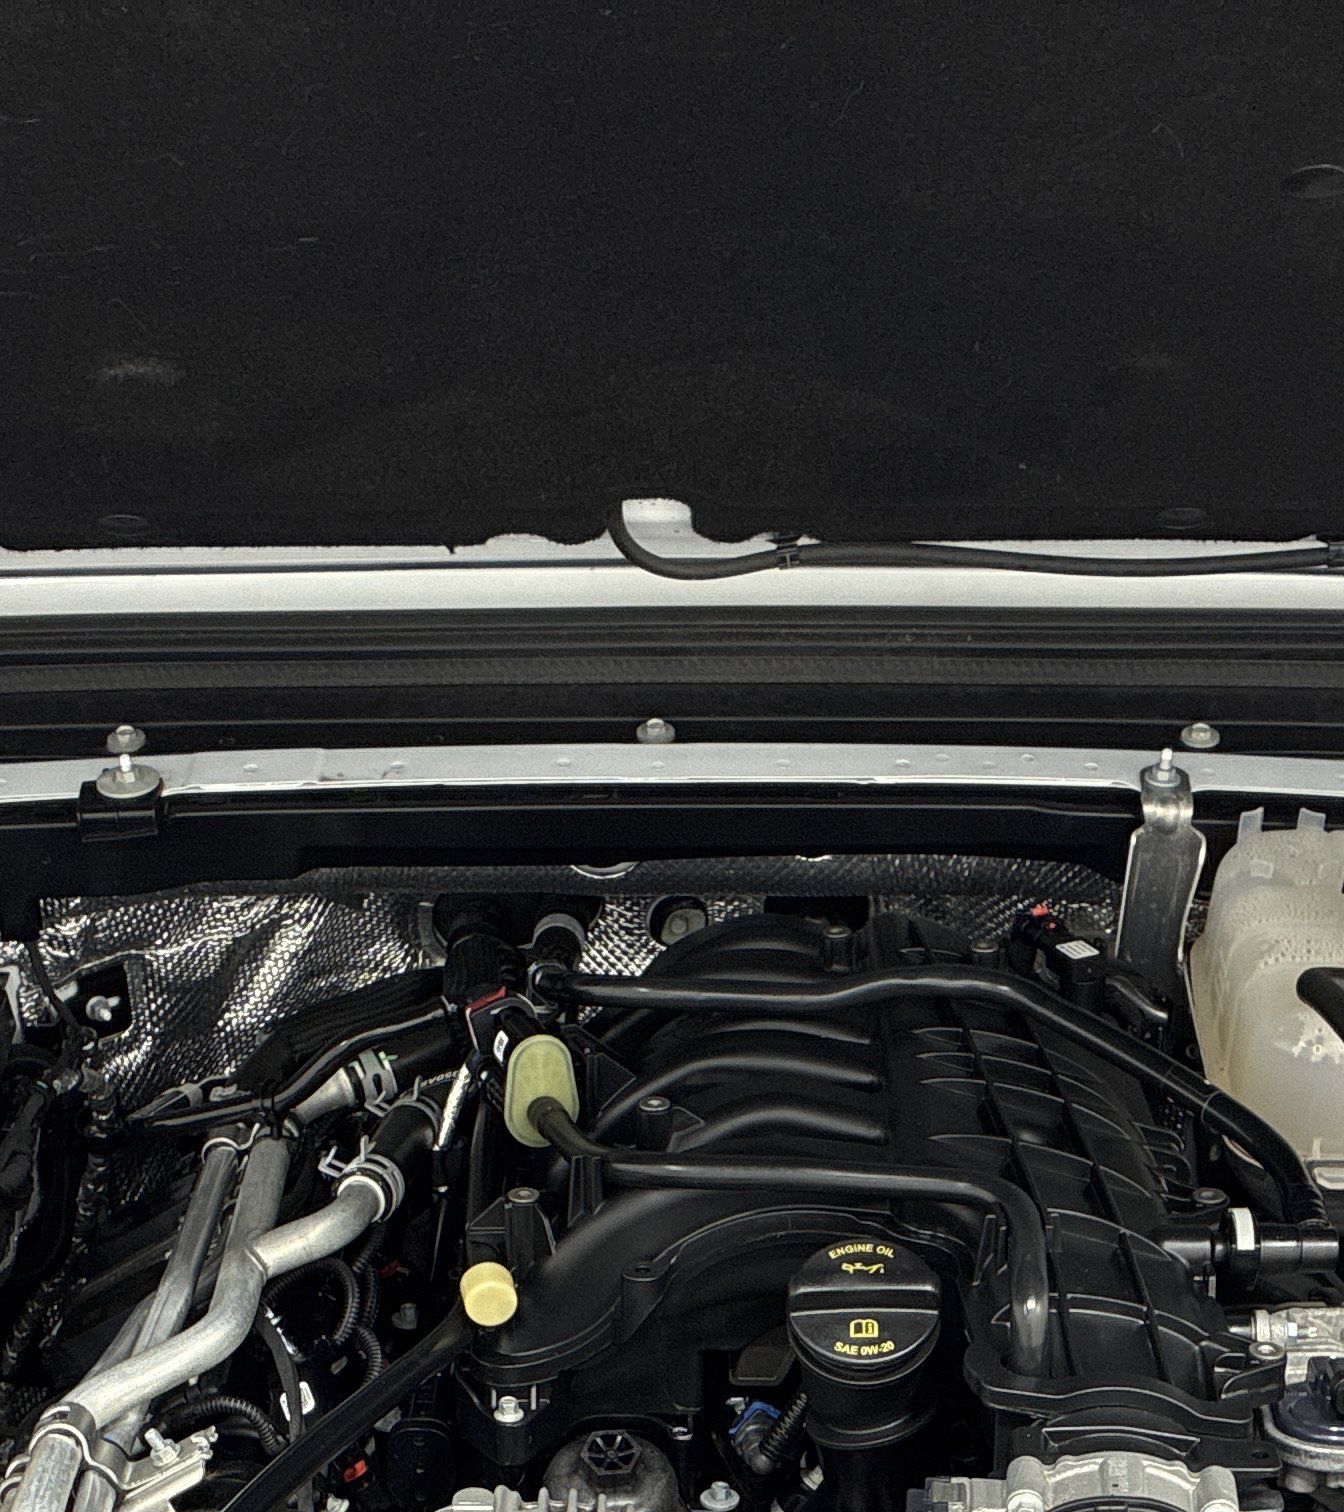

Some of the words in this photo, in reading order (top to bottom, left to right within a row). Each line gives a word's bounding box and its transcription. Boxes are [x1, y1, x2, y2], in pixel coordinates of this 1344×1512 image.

[828, 1243, 875, 1260] ENGINE
[876, 1245, 895, 1259] OIL
[833, 1341, 859, 1356] SAE
[860, 1340, 895, 1356] 0W-20
